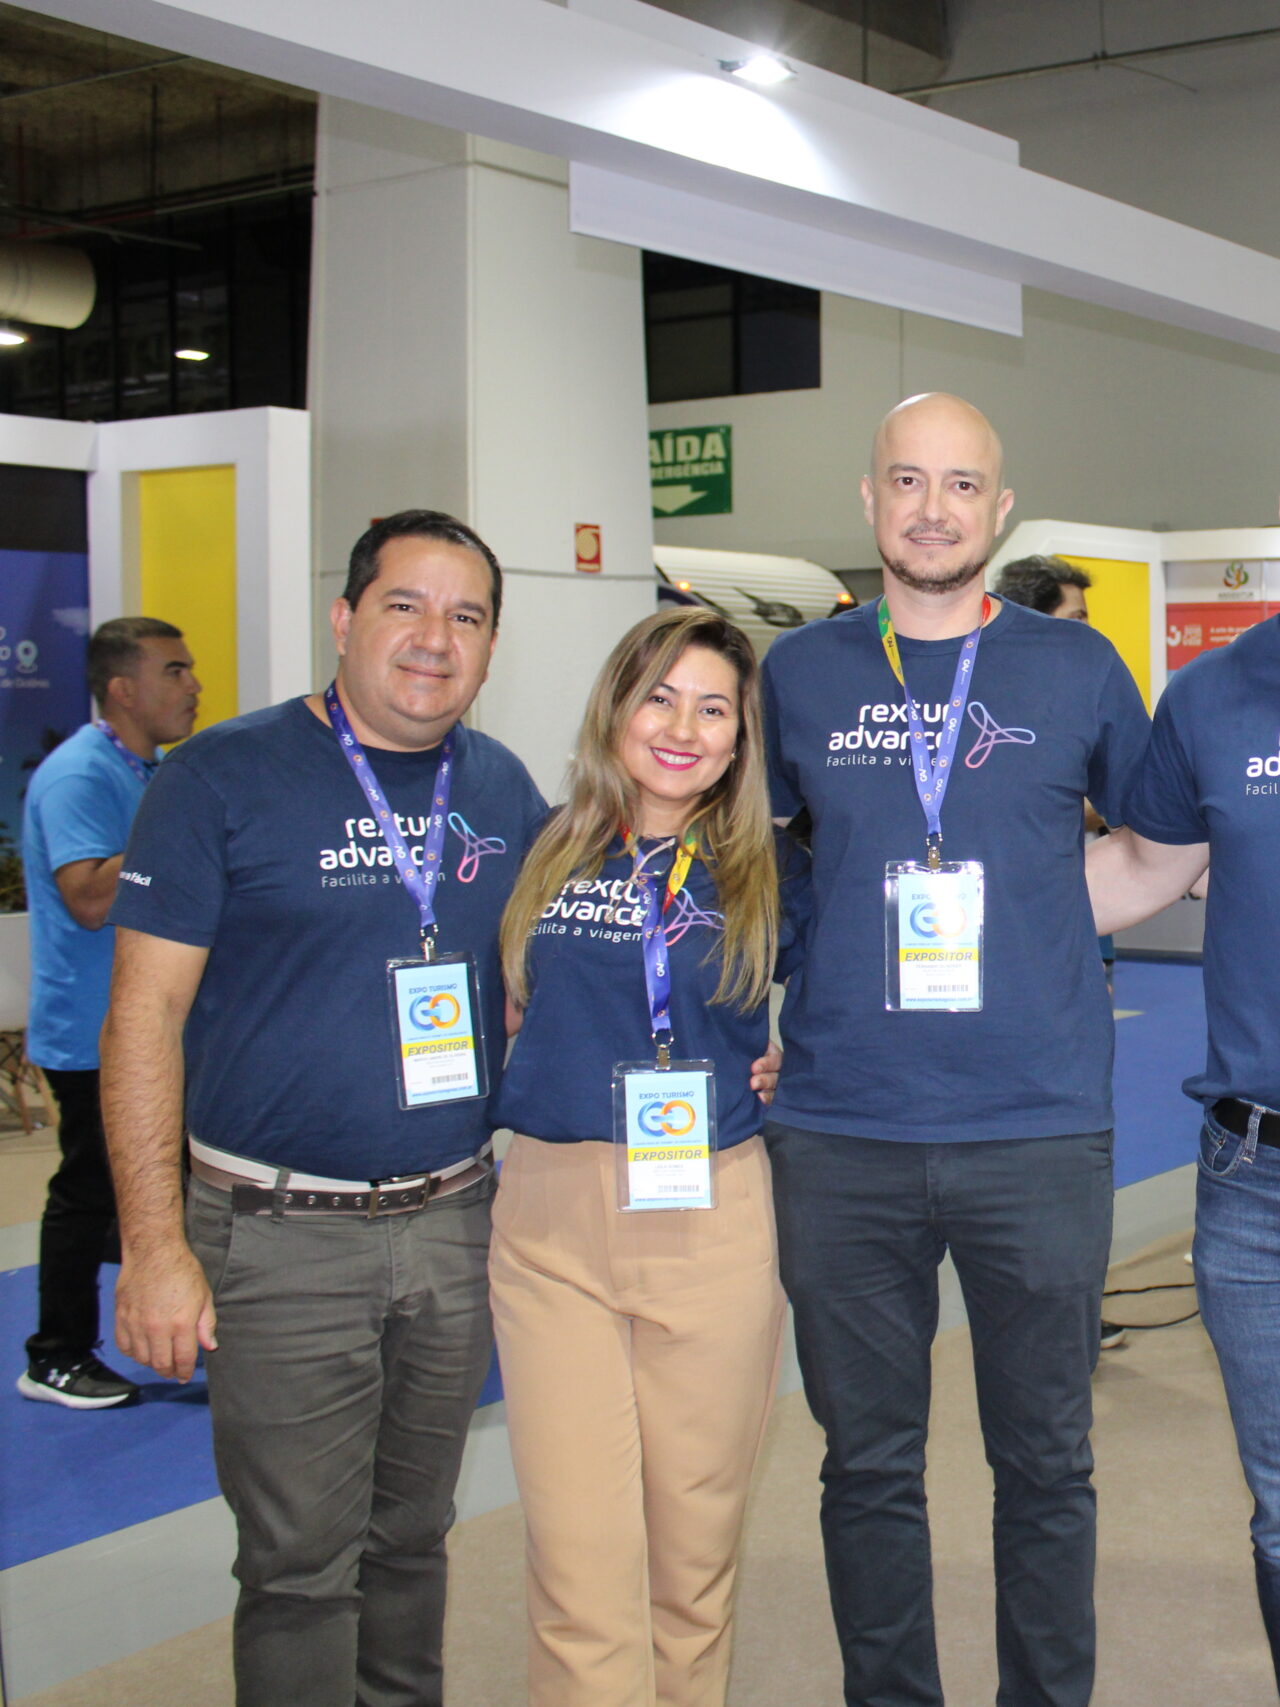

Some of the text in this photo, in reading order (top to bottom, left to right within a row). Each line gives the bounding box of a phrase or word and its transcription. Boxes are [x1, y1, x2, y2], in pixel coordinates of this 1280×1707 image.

[650, 432, 726, 464] AÍDA
[883, 757, 892, 765] a
[345, 813, 431, 838] retu
[320, 841, 424, 870] advac
[561, 879, 640, 904] rextu
[541, 897, 643, 926] dvance
[905, 952, 973, 962] EXPOSITOR
[429, 983, 457, 992] TURISMO
[408, 1041, 468, 1057] EXPOSITOR
[634, 1150, 702, 1161] EXPOSITOR
